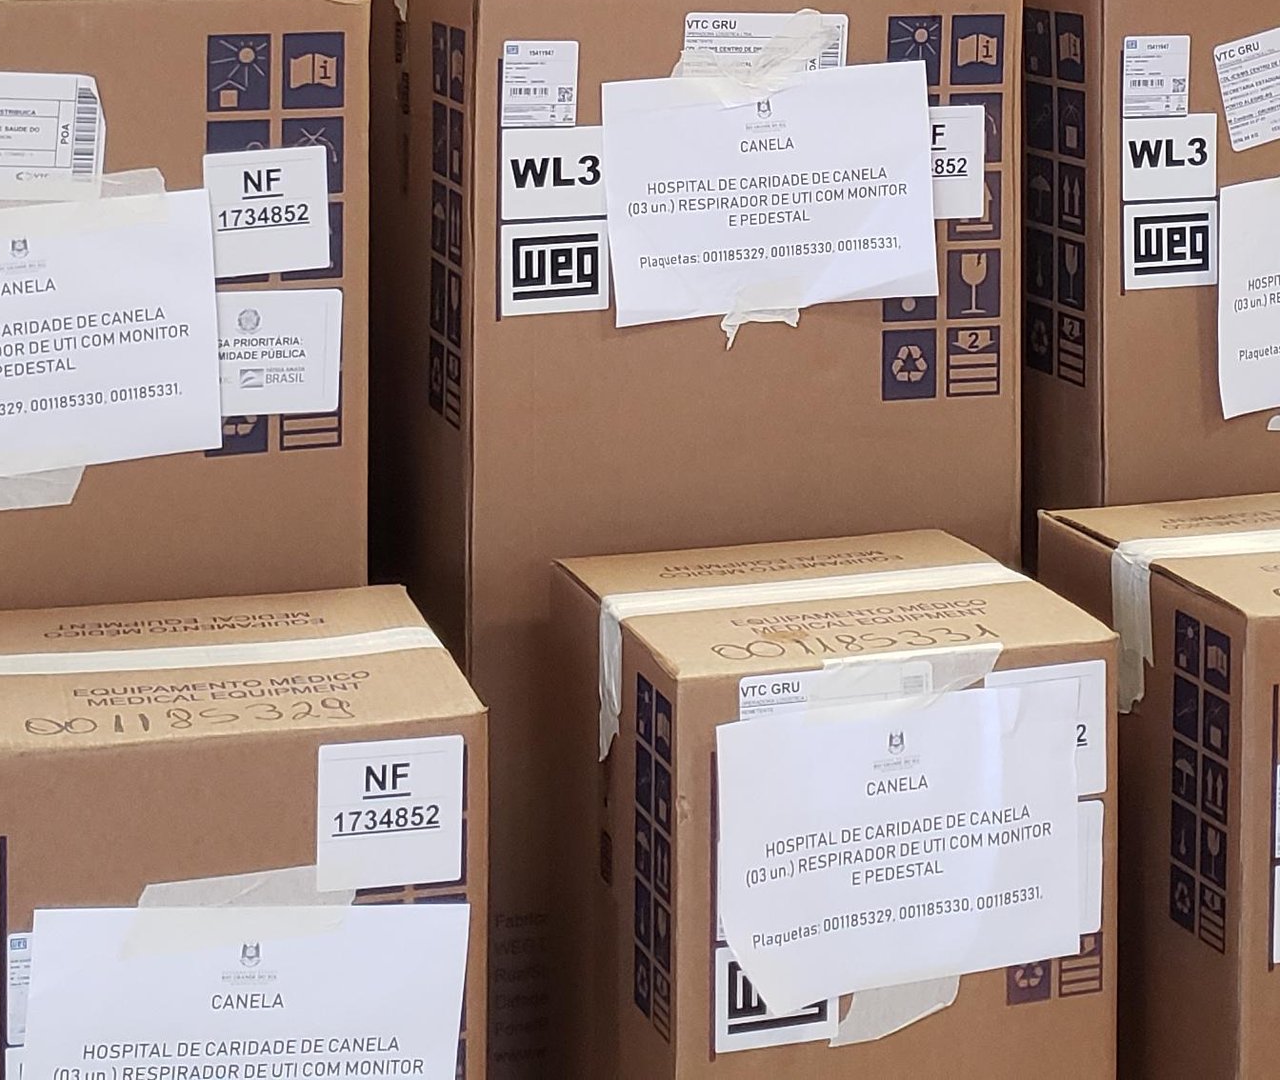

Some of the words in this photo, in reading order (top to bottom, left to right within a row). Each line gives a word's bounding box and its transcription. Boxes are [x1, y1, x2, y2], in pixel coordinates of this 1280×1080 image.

[686, 20, 709, 29] VTC
[711, 20, 737, 30] GRU
[1215, 49, 1235, 62] VTC
[1237, 42, 1260, 56] GRU
[60, 123, 70, 145] POA
[741, 137, 794, 152] CANELA
[1128, 137, 1208, 168] WL3
[243, 169, 282, 193] NF
[510, 155, 601, 189] WL3
[648, 179, 715, 195] HOSPITAL
[719, 178, 737, 191] DE
[740, 173, 809, 190] CARIDADE
[812, 172, 830, 184] DE
[833, 167, 887, 182] CANELA
[628, 202, 647, 218] (03
[651, 199, 674, 214] un.)
[679, 195, 768, 211] RESPIRADOR
[772, 193, 789, 206] DE
[792, 191, 812, 204] UTI
[816, 188, 844, 202] COM
[848, 184, 907, 200] MONITOR
[218, 203, 309, 227] 1734852
[729, 215, 737, 226] E
[740, 209, 810, 226] PEDESTAL
[640, 254, 700, 268] Plaquetas:
[1234, 298, 1249, 312] (03
[1251, 293, 1268, 309] un.)
[77, 314, 98, 329] DE
[102, 306, 165, 326] CANELA
[29, 339, 50, 354] DE
[54, 336, 77, 351] UTI
[81, 332, 114, 348] COM
[120, 324, 189, 344] MONITOR
[261, 349, 306, 359] PÚBLICA
[265, 373, 304, 384] BRASIL
[731, 606, 894, 627] EQUIPAMENTO
[750, 619, 862, 635] MEDICAL
[867, 607, 987, 627] EQUIPMENT
[73, 678, 262, 697] EQUIPAMENTO
[270, 670, 370, 685] MÉDICO
[87, 692, 206, 707] MEDICAL
[210, 681, 362, 701] EQUIPMENT
[741, 684, 767, 697] VTC
[771, 681, 800, 694] GRU
[365, 763, 410, 792] NF
[867, 774, 928, 796] CANELA
[334, 804, 440, 832] 1734852
[766, 831, 838, 858] HOSPITAL
[842, 828, 861, 843] DE
[865, 816, 943, 840] CARIDADE
[946, 813, 966, 828] DE
[970, 804, 1030, 826] CANELA
[746, 868, 766, 888] (03
[770, 859, 794, 880] un.)
[799, 845, 896, 874] RESPIRADOR
[900, 841, 920, 857] DE
[924, 837, 945, 853] UTI
[950, 833, 982, 850] COM
[988, 822, 1051, 846] MONITOR
[852, 871, 861, 886] E
[865, 860, 944, 884] PEDESTAL
[753, 924, 820, 950] Plaquetas:
[212, 993, 284, 1010] CANELA
[83, 1042, 173, 1060] HOSPITAL
[177, 1042, 202, 1057] DE
[206, 1040, 297, 1056] CARIDADE
[300, 1039, 324, 1054] DE
[328, 1036, 399, 1053] CANELA
[122, 1064, 239, 1080] RESPIRADOR
[244, 1064, 267, 1079] DE
[271, 1063, 299, 1078] UTI
[302, 1061, 336, 1078] COM
[344, 1059, 425, 1077] MONITOR
